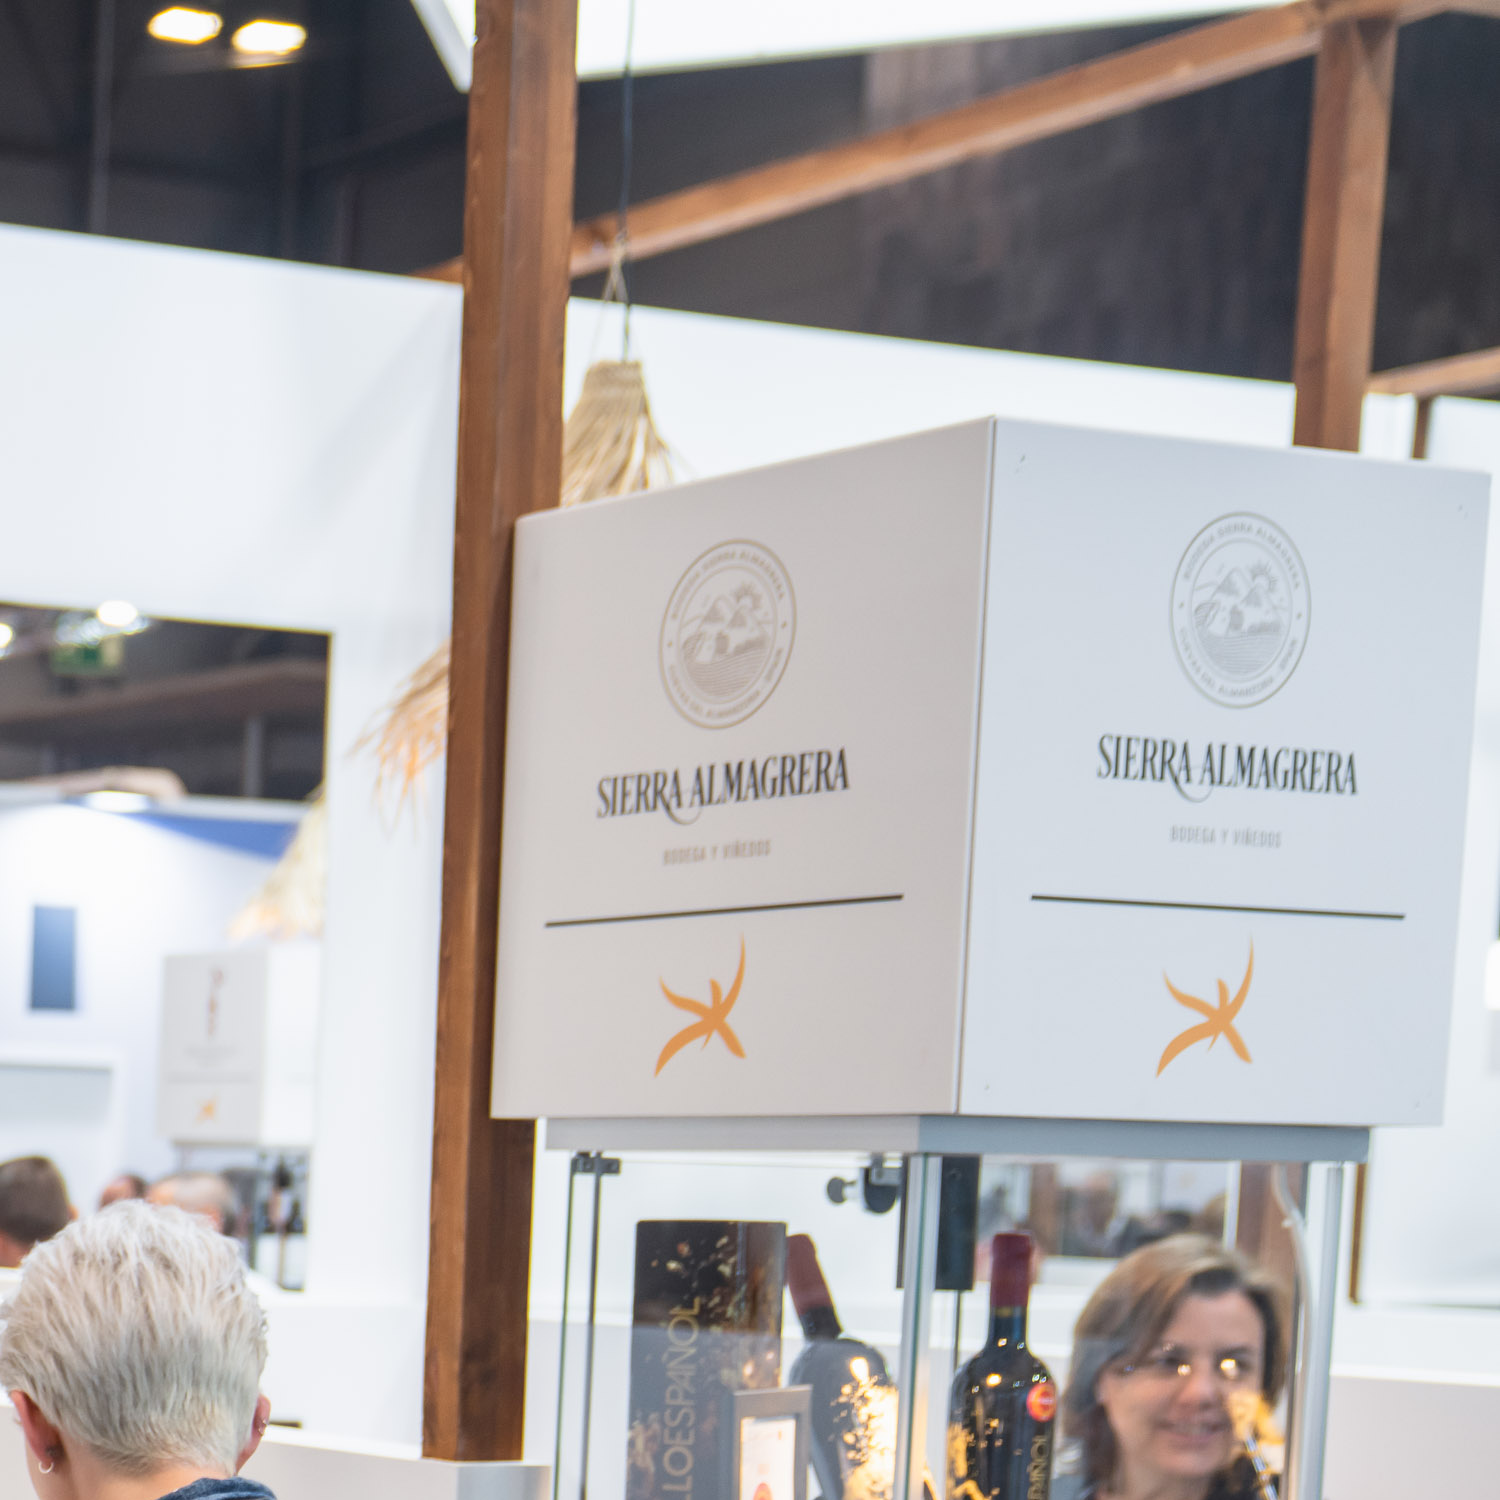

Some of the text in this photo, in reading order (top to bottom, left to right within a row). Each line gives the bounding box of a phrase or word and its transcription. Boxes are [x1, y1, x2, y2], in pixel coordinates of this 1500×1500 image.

[597, 746, 850, 825] SIERRA ALMAGRERA
[1097, 733, 1359, 803] SIERRA ALMAGRERA
